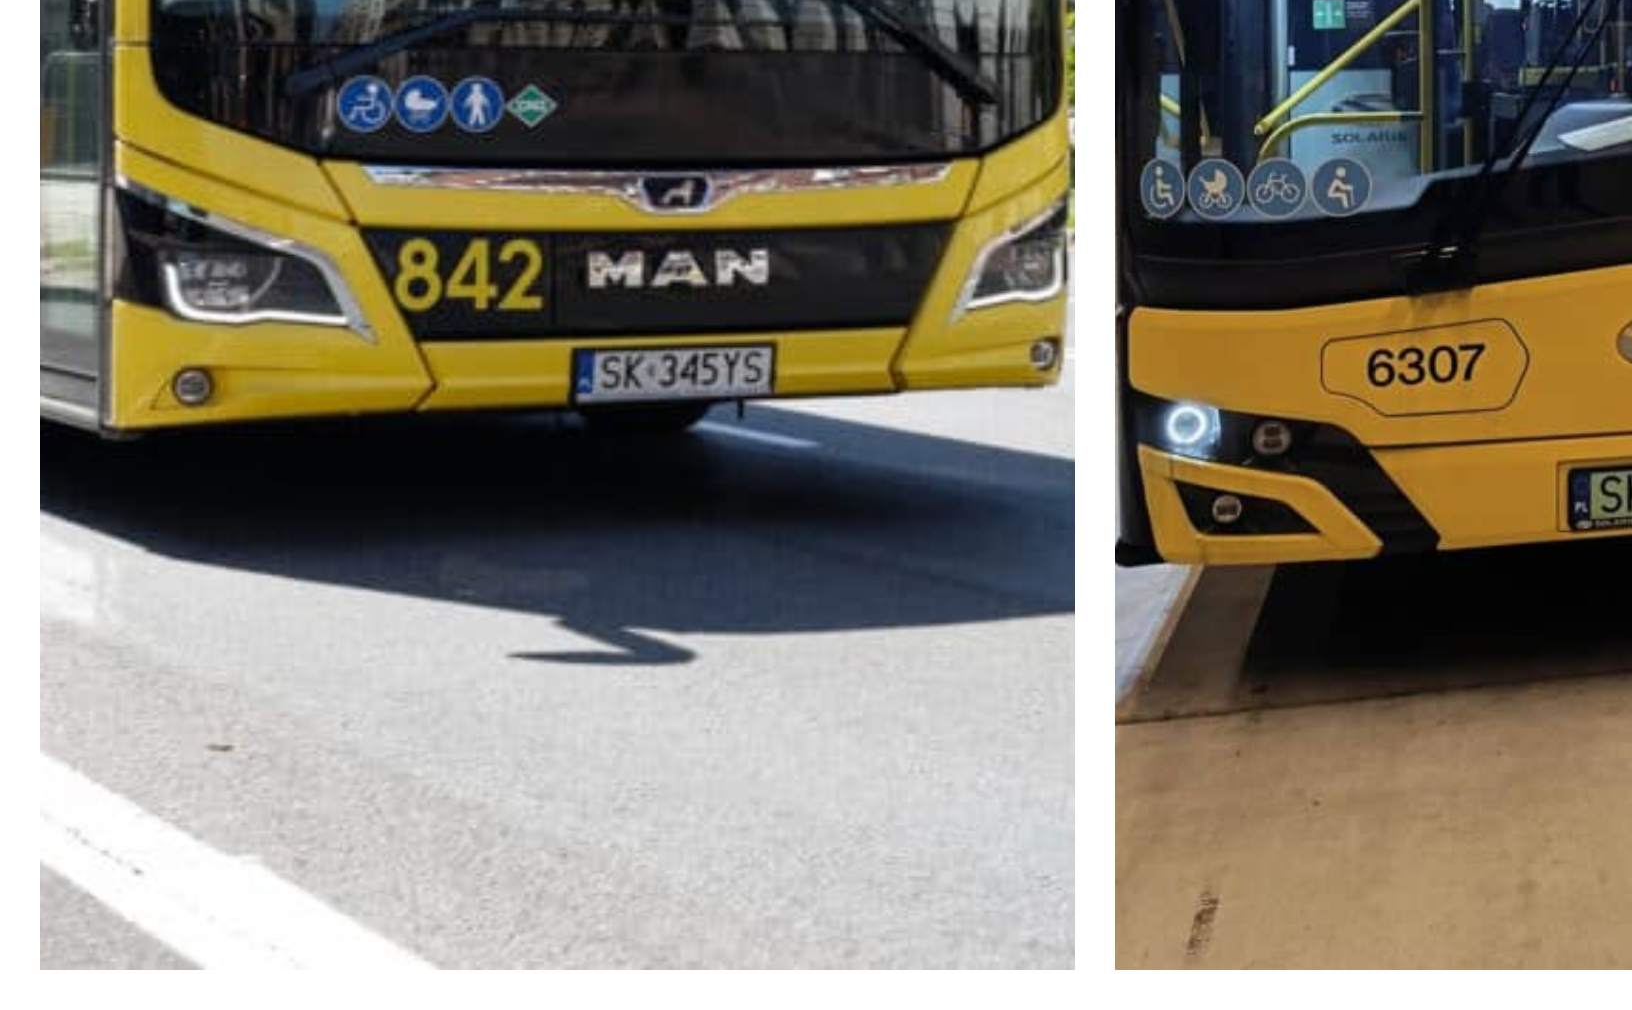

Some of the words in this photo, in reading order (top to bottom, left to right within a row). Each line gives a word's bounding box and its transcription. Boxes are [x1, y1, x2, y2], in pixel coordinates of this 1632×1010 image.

[395, 238, 543, 312] 842
[586, 250, 770, 288] MAN
[601, 354, 643, 390] SK
[658, 350, 763, 388] 345YS
[1365, 343, 1487, 388] 6307
